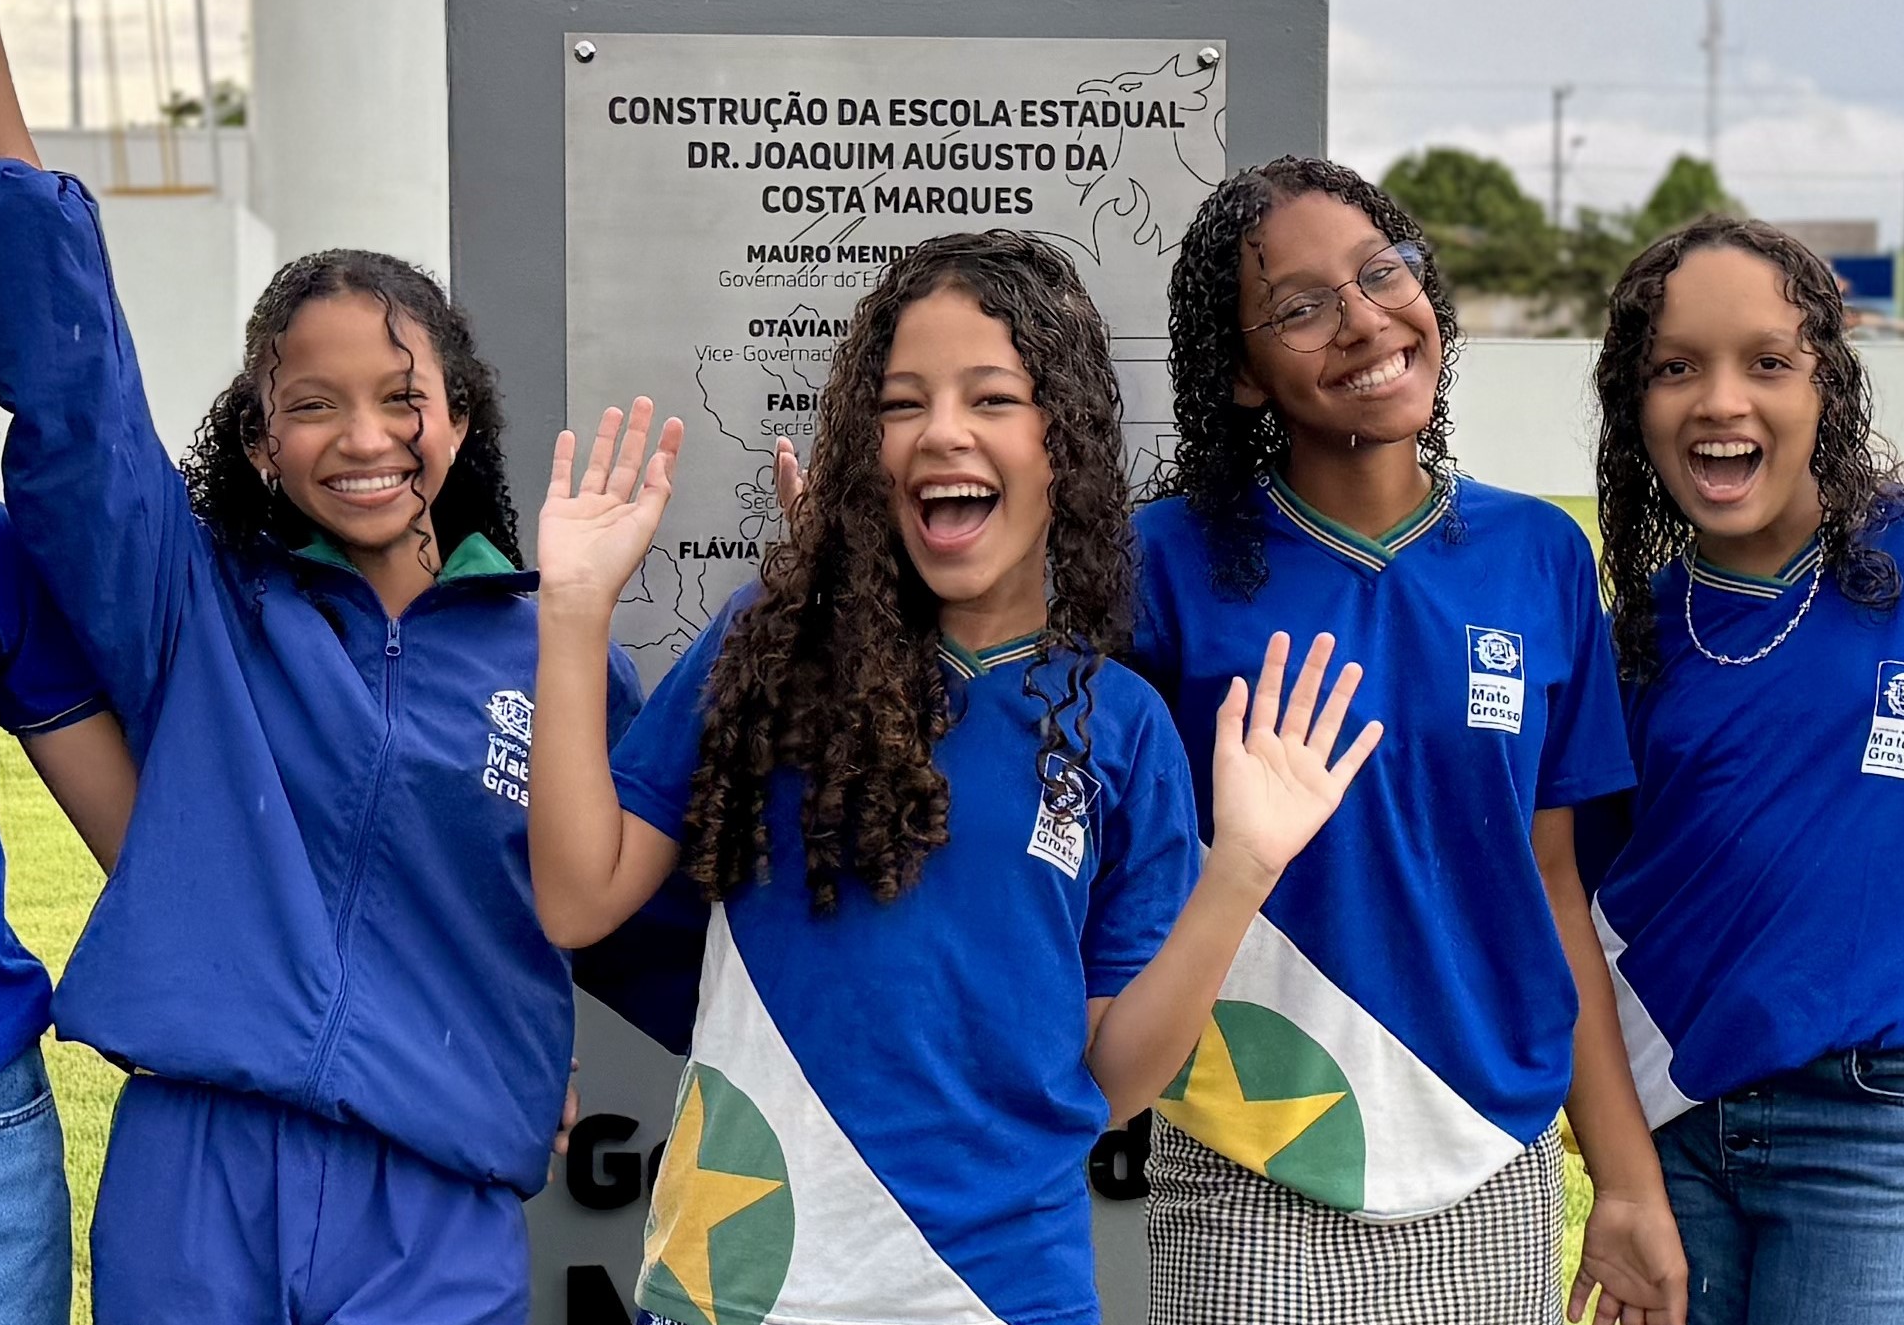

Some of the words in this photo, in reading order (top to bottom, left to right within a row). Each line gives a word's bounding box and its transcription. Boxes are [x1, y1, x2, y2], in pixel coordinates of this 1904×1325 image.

[607, 91, 829, 133] CONSTRUÇÃO
[836, 98, 882, 127] DA
[889, 98, 1012, 128] ESCOLA
[1019, 99, 1187, 129] ESTADUAL
[688, 141, 739, 170] DR.
[745, 141, 894, 171] JOAQUIM
[902, 142, 1056, 171] AUGUSTO
[1065, 143, 1108, 171] DA
[761, 185, 866, 214] COSTA
[874, 186, 1033, 216] MARQUES
[747, 244, 831, 264] MAURO
[718, 270, 829, 288] Governador
[833, 270, 857, 288] do
[748, 319, 849, 338] OTAVIAN
[694, 344, 833, 363] Vice-Governad
[767, 393, 818, 412] FABI
[760, 418, 815, 437] Secre
[679, 536, 761, 560] FLÁVIA
[1471, 688, 1510, 705] Mato
[1470, 702, 1520, 723] Grosso
[487, 743, 529, 782] Mat
[483, 767, 529, 807] Gros
